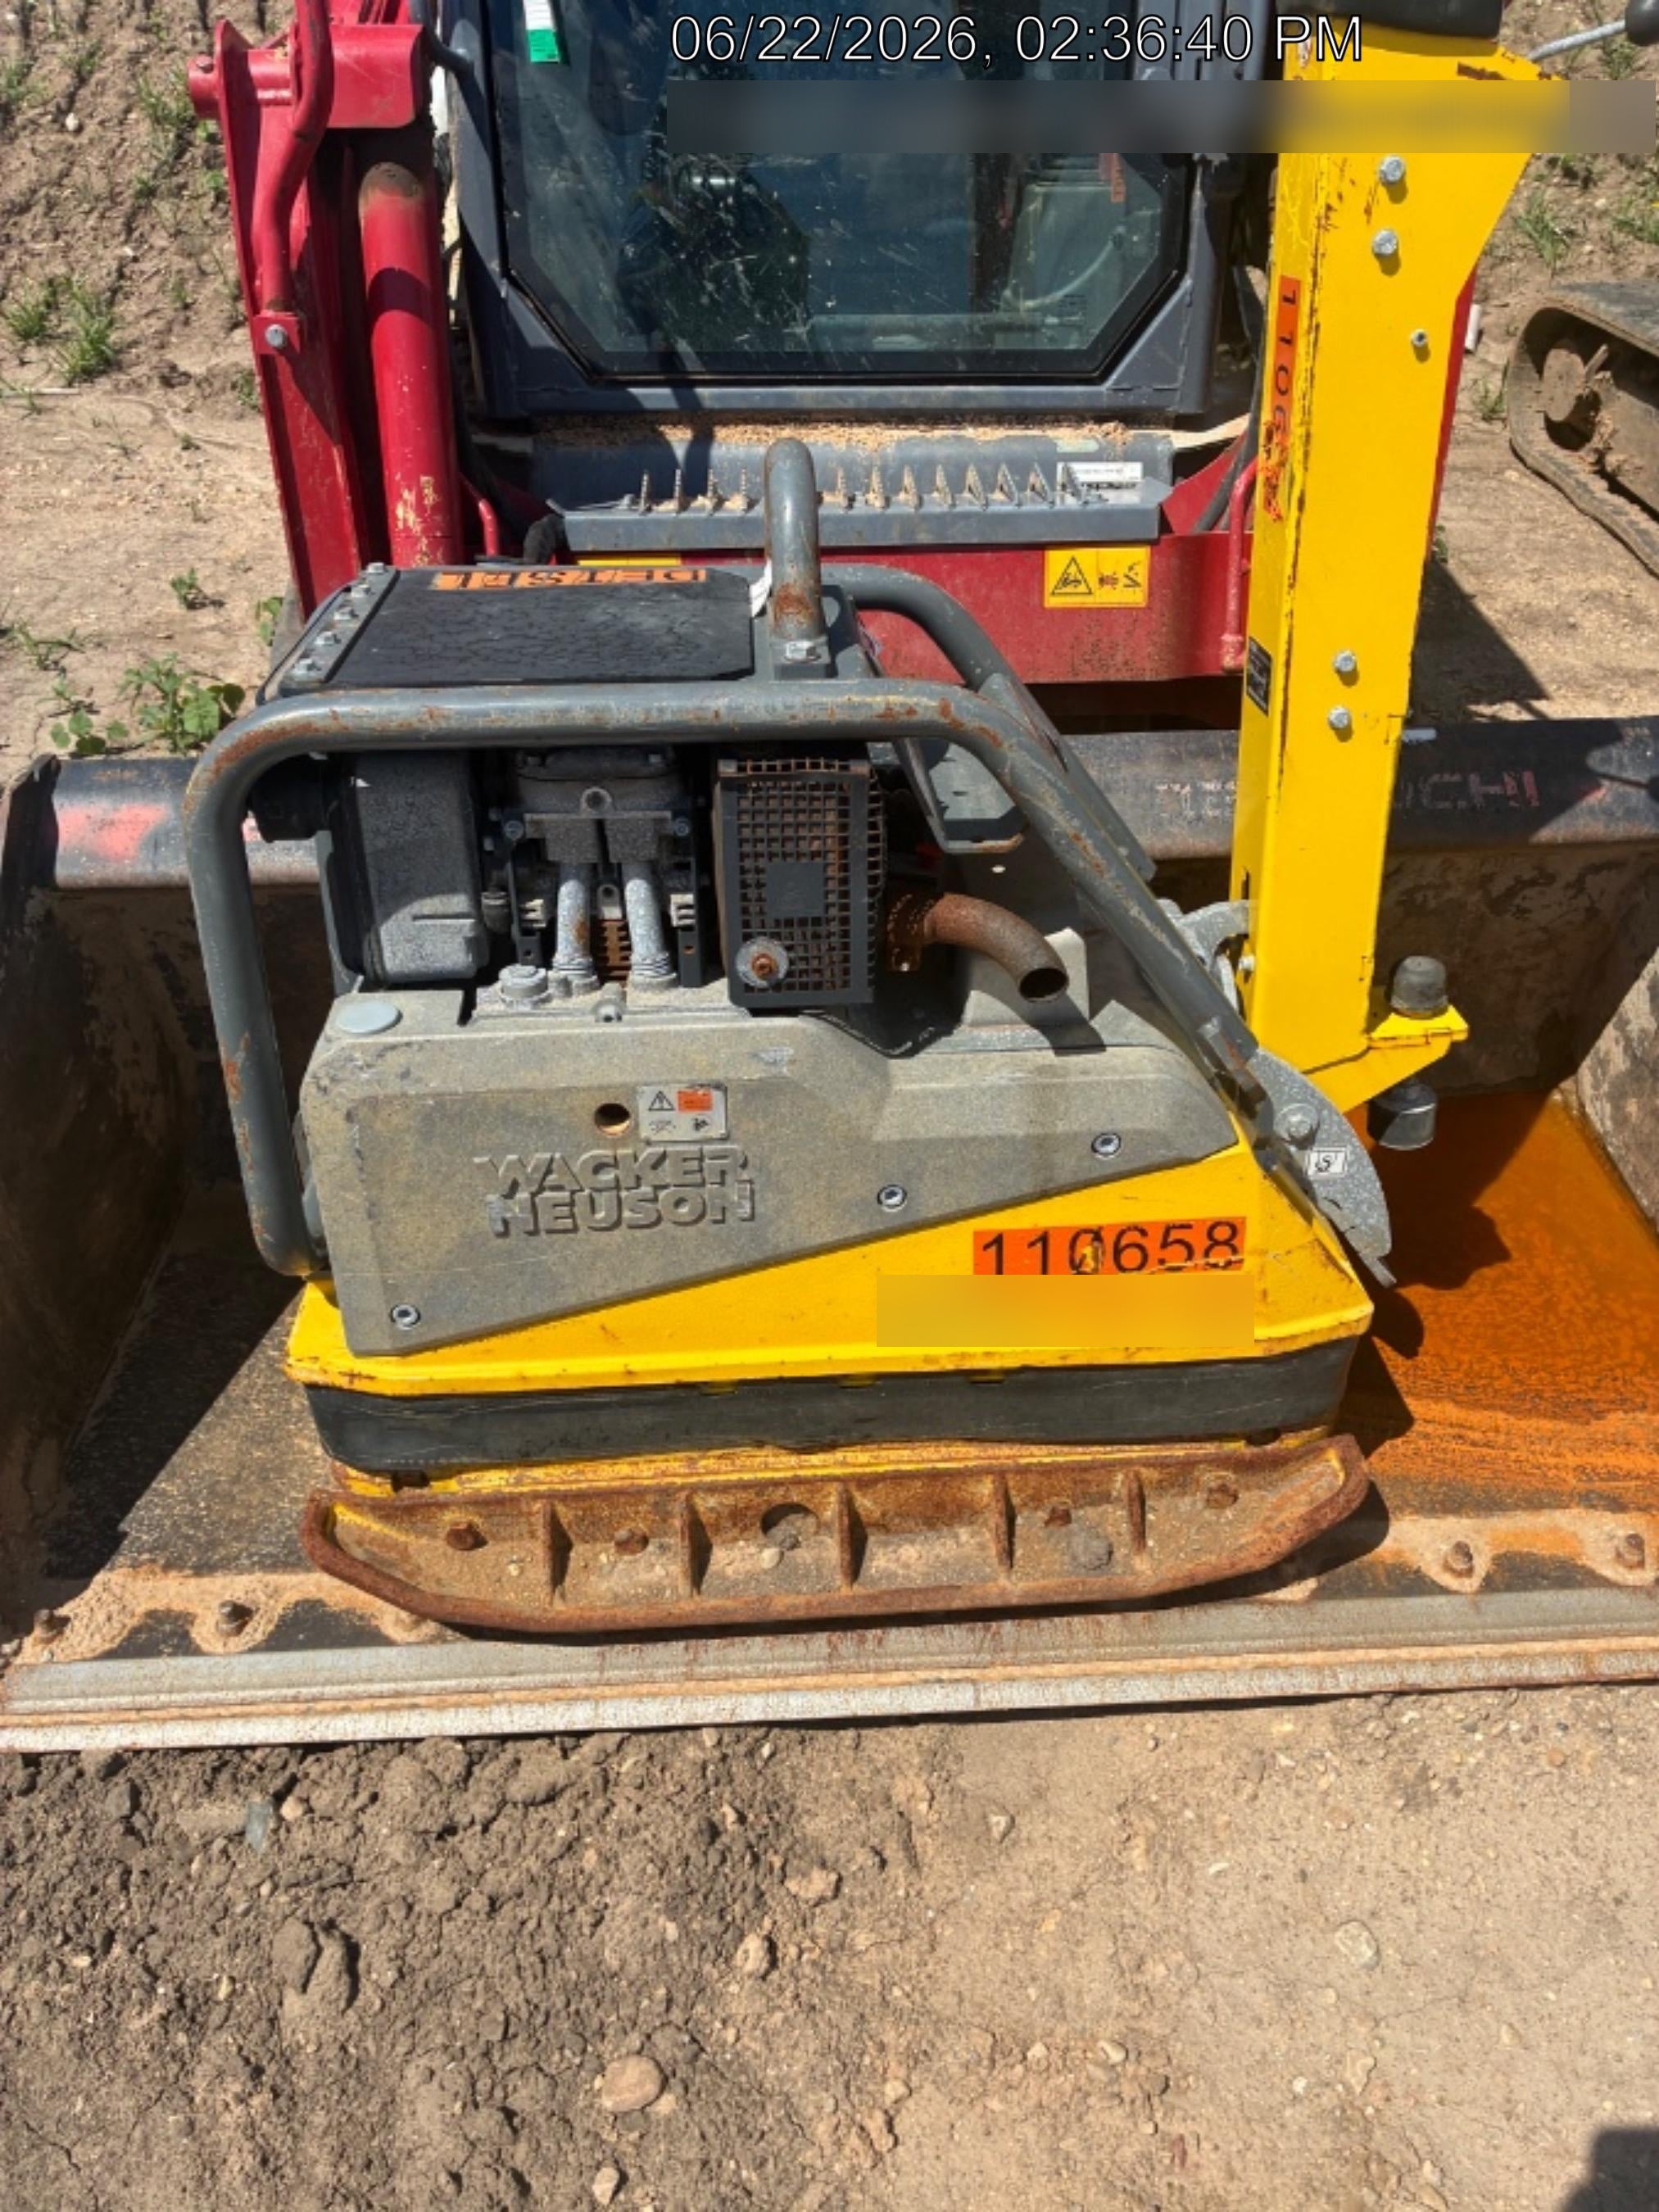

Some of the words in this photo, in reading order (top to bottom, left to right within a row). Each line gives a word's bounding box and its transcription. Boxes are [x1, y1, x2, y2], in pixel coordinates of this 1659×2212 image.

[473, 1145, 750, 1194] WACKER
[486, 1180, 756, 1237] NEUSON
[981, 1219, 1240, 1275] 110658
